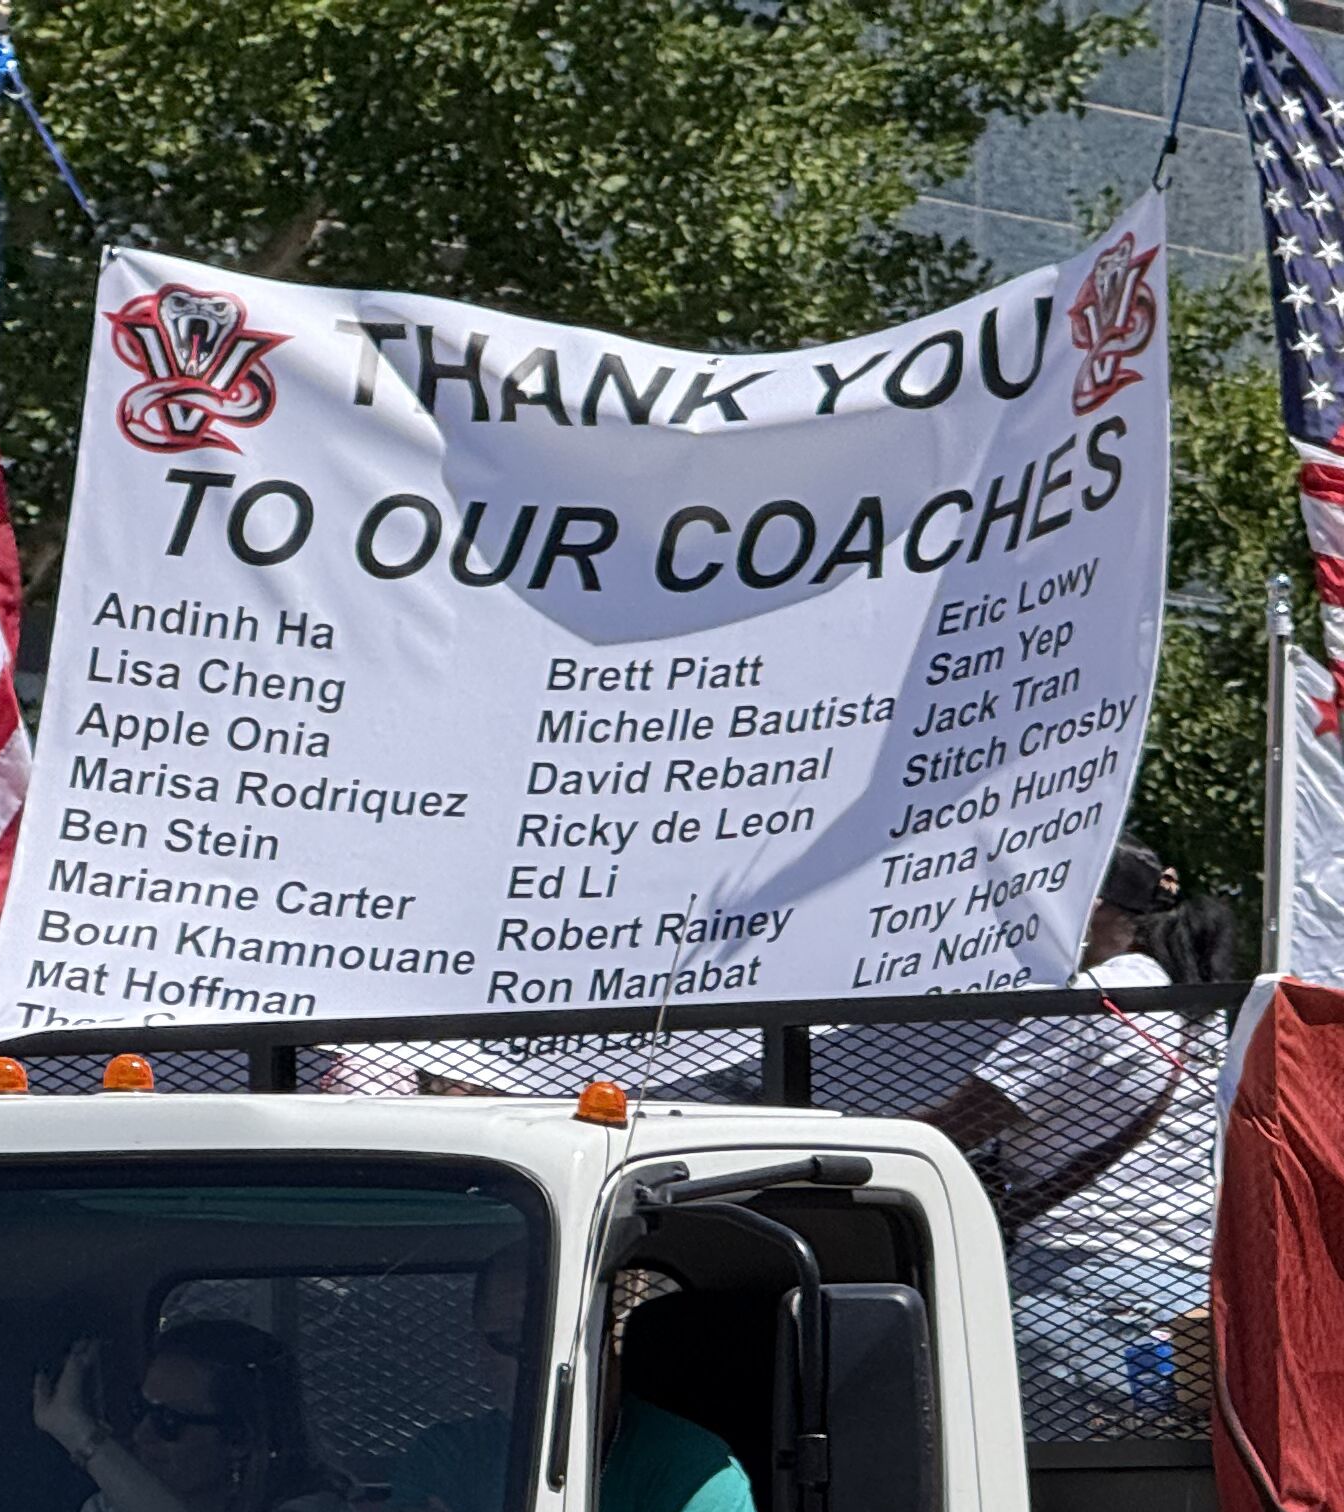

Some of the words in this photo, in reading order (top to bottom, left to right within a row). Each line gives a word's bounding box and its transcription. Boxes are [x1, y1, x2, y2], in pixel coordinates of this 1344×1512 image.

[335, 318, 775, 426] THANK
[814, 296, 1053, 414] YOU
[164, 468, 315, 567] TO
[356, 492, 619, 592] OUR
[655, 415, 1127, 592] COACHES
[92, 592, 259, 643] Andinh
[276, 609, 335, 650] Ha
[936, 593, 1008, 637] Eric
[1016, 557, 1100, 615] Lowy
[87, 646, 181, 691] Lisa
[198, 658, 346, 714] Cheng
[546, 657, 655, 692] Brett
[666, 655, 764, 691] Piatt
[925, 645, 1005, 687] Sam
[1018, 620, 1074, 662] Yep
[75, 702, 210, 752] Apple
[227, 716, 330, 758] Onia
[536, 707, 714, 744] Michelle
[727, 692, 896, 739] Bautista
[912, 689, 1000, 738] Jack
[1011, 667, 1081, 713] Tran
[902, 735, 1008, 788] Stitch
[1018, 694, 1138, 758] Crosby
[68, 755, 220, 803] Marisa
[526, 760, 652, 796] David
[663, 746, 834, 793] Rebanal
[888, 783, 1001, 840] Jacob
[1010, 744, 1119, 810] Hungh
[59, 807, 148, 849] Ben
[164, 818, 279, 861] Stein
[516, 813, 640, 856] Ricky
[651, 810, 701, 845] de
[714, 807, 815, 841] Leon
[876, 844, 978, 889] Tiana
[986, 801, 1103, 863] Jordon
[48, 858, 259, 911] Marianne
[275, 880, 417, 921] Carter
[506, 865, 566, 900] Ed
[578, 864, 620, 899] Li
[868, 897, 957, 939] Tony
[964, 858, 1072, 916] Hoang
[37, 909, 158, 951] Boun
[174, 921, 476, 976] Khamnouane
[496, 916, 643, 952] Robert
[654, 907, 795, 946] Rainey
[26, 959, 110, 996] Mat
[122, 967, 316, 1017] Hoffman
[486, 970, 573, 1004] Ron
[587, 955, 762, 1002] Manabat
[851, 951, 922, 990] Lira
